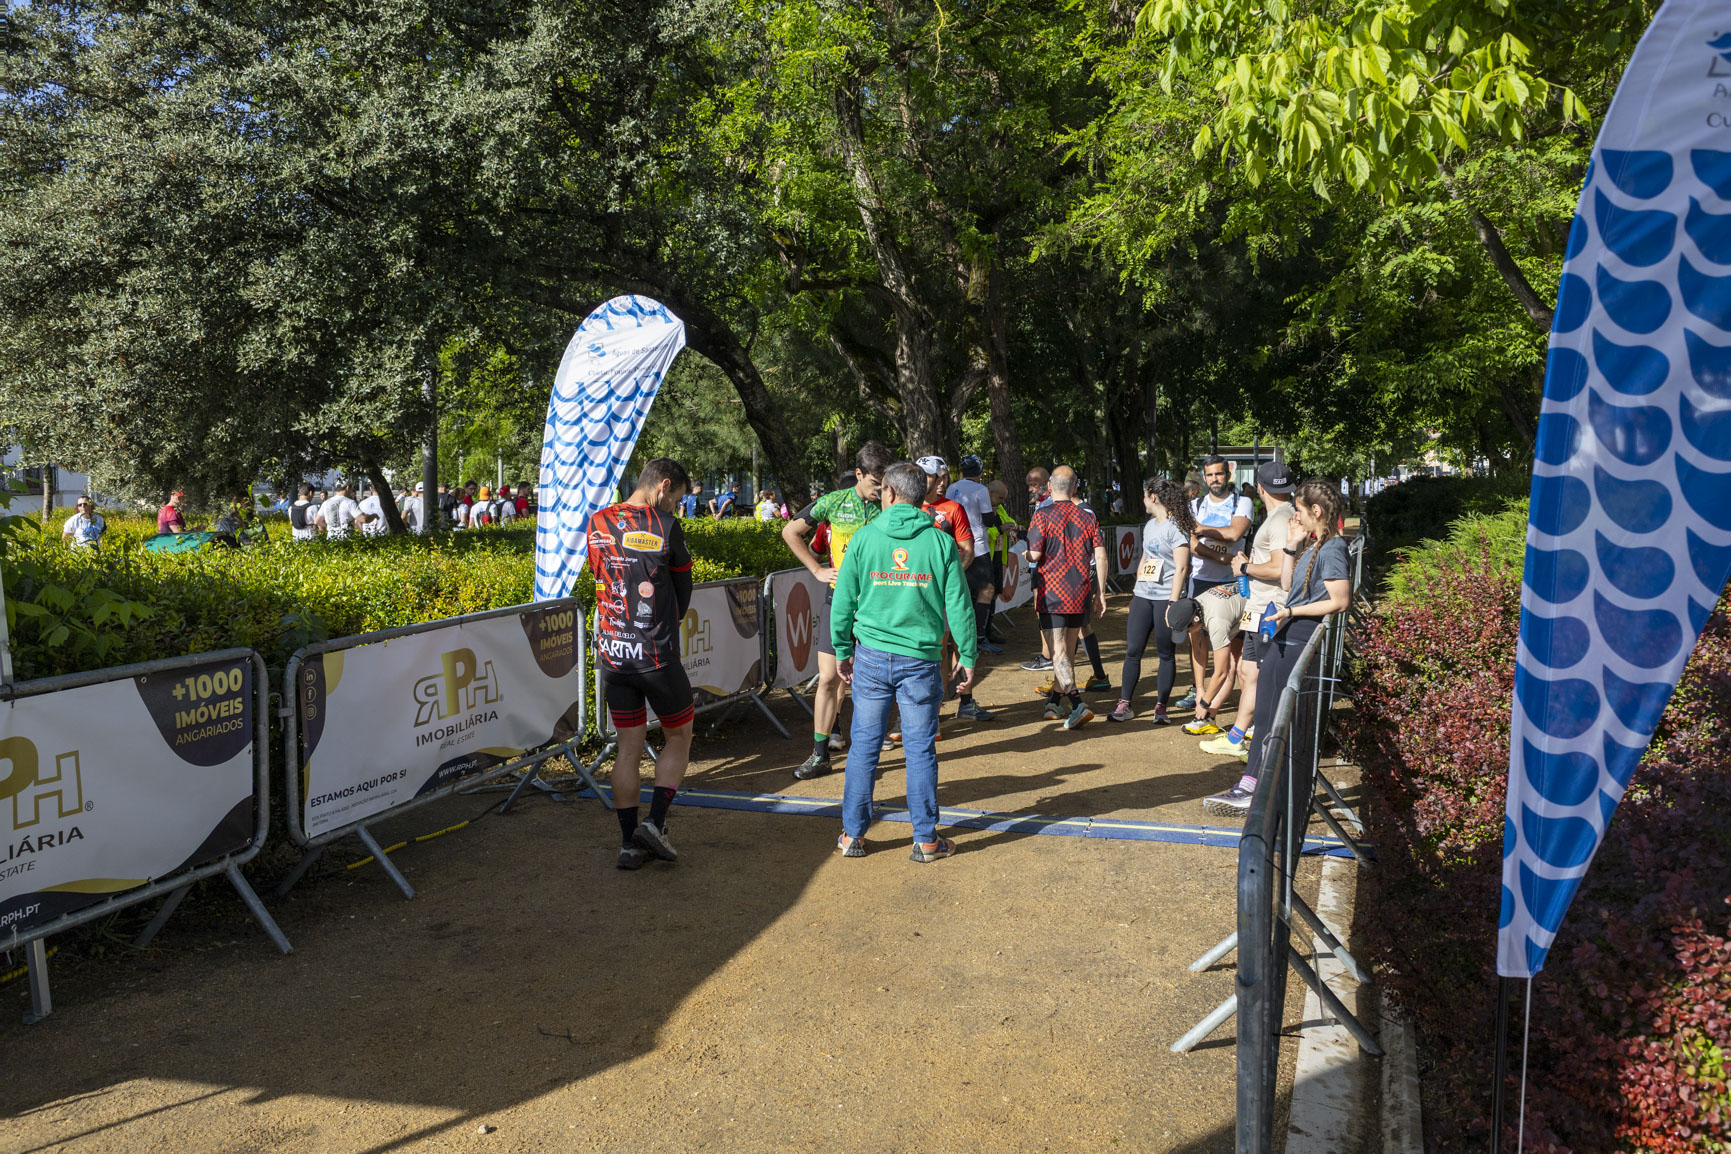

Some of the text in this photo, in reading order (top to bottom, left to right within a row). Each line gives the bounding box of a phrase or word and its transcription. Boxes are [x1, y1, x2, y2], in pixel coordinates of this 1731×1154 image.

[1121, 544, 1133, 559] W
[539, 610, 573, 633] +1000
[787, 609, 810, 647] W
[539, 645, 573, 662] ANGARIADOS
[540, 632, 573, 650] IMÓVEIS
[172, 667, 244, 702] +1000
[175, 696, 244, 729] IMÓVEIS
[175, 717, 244, 747] ANGARIADOS
[416, 710, 499, 747] IMOBILIÁRIA
[457, 731, 476, 744] ESTATE
[310, 768, 407, 808] ESTAMOS AQUI POR SI
